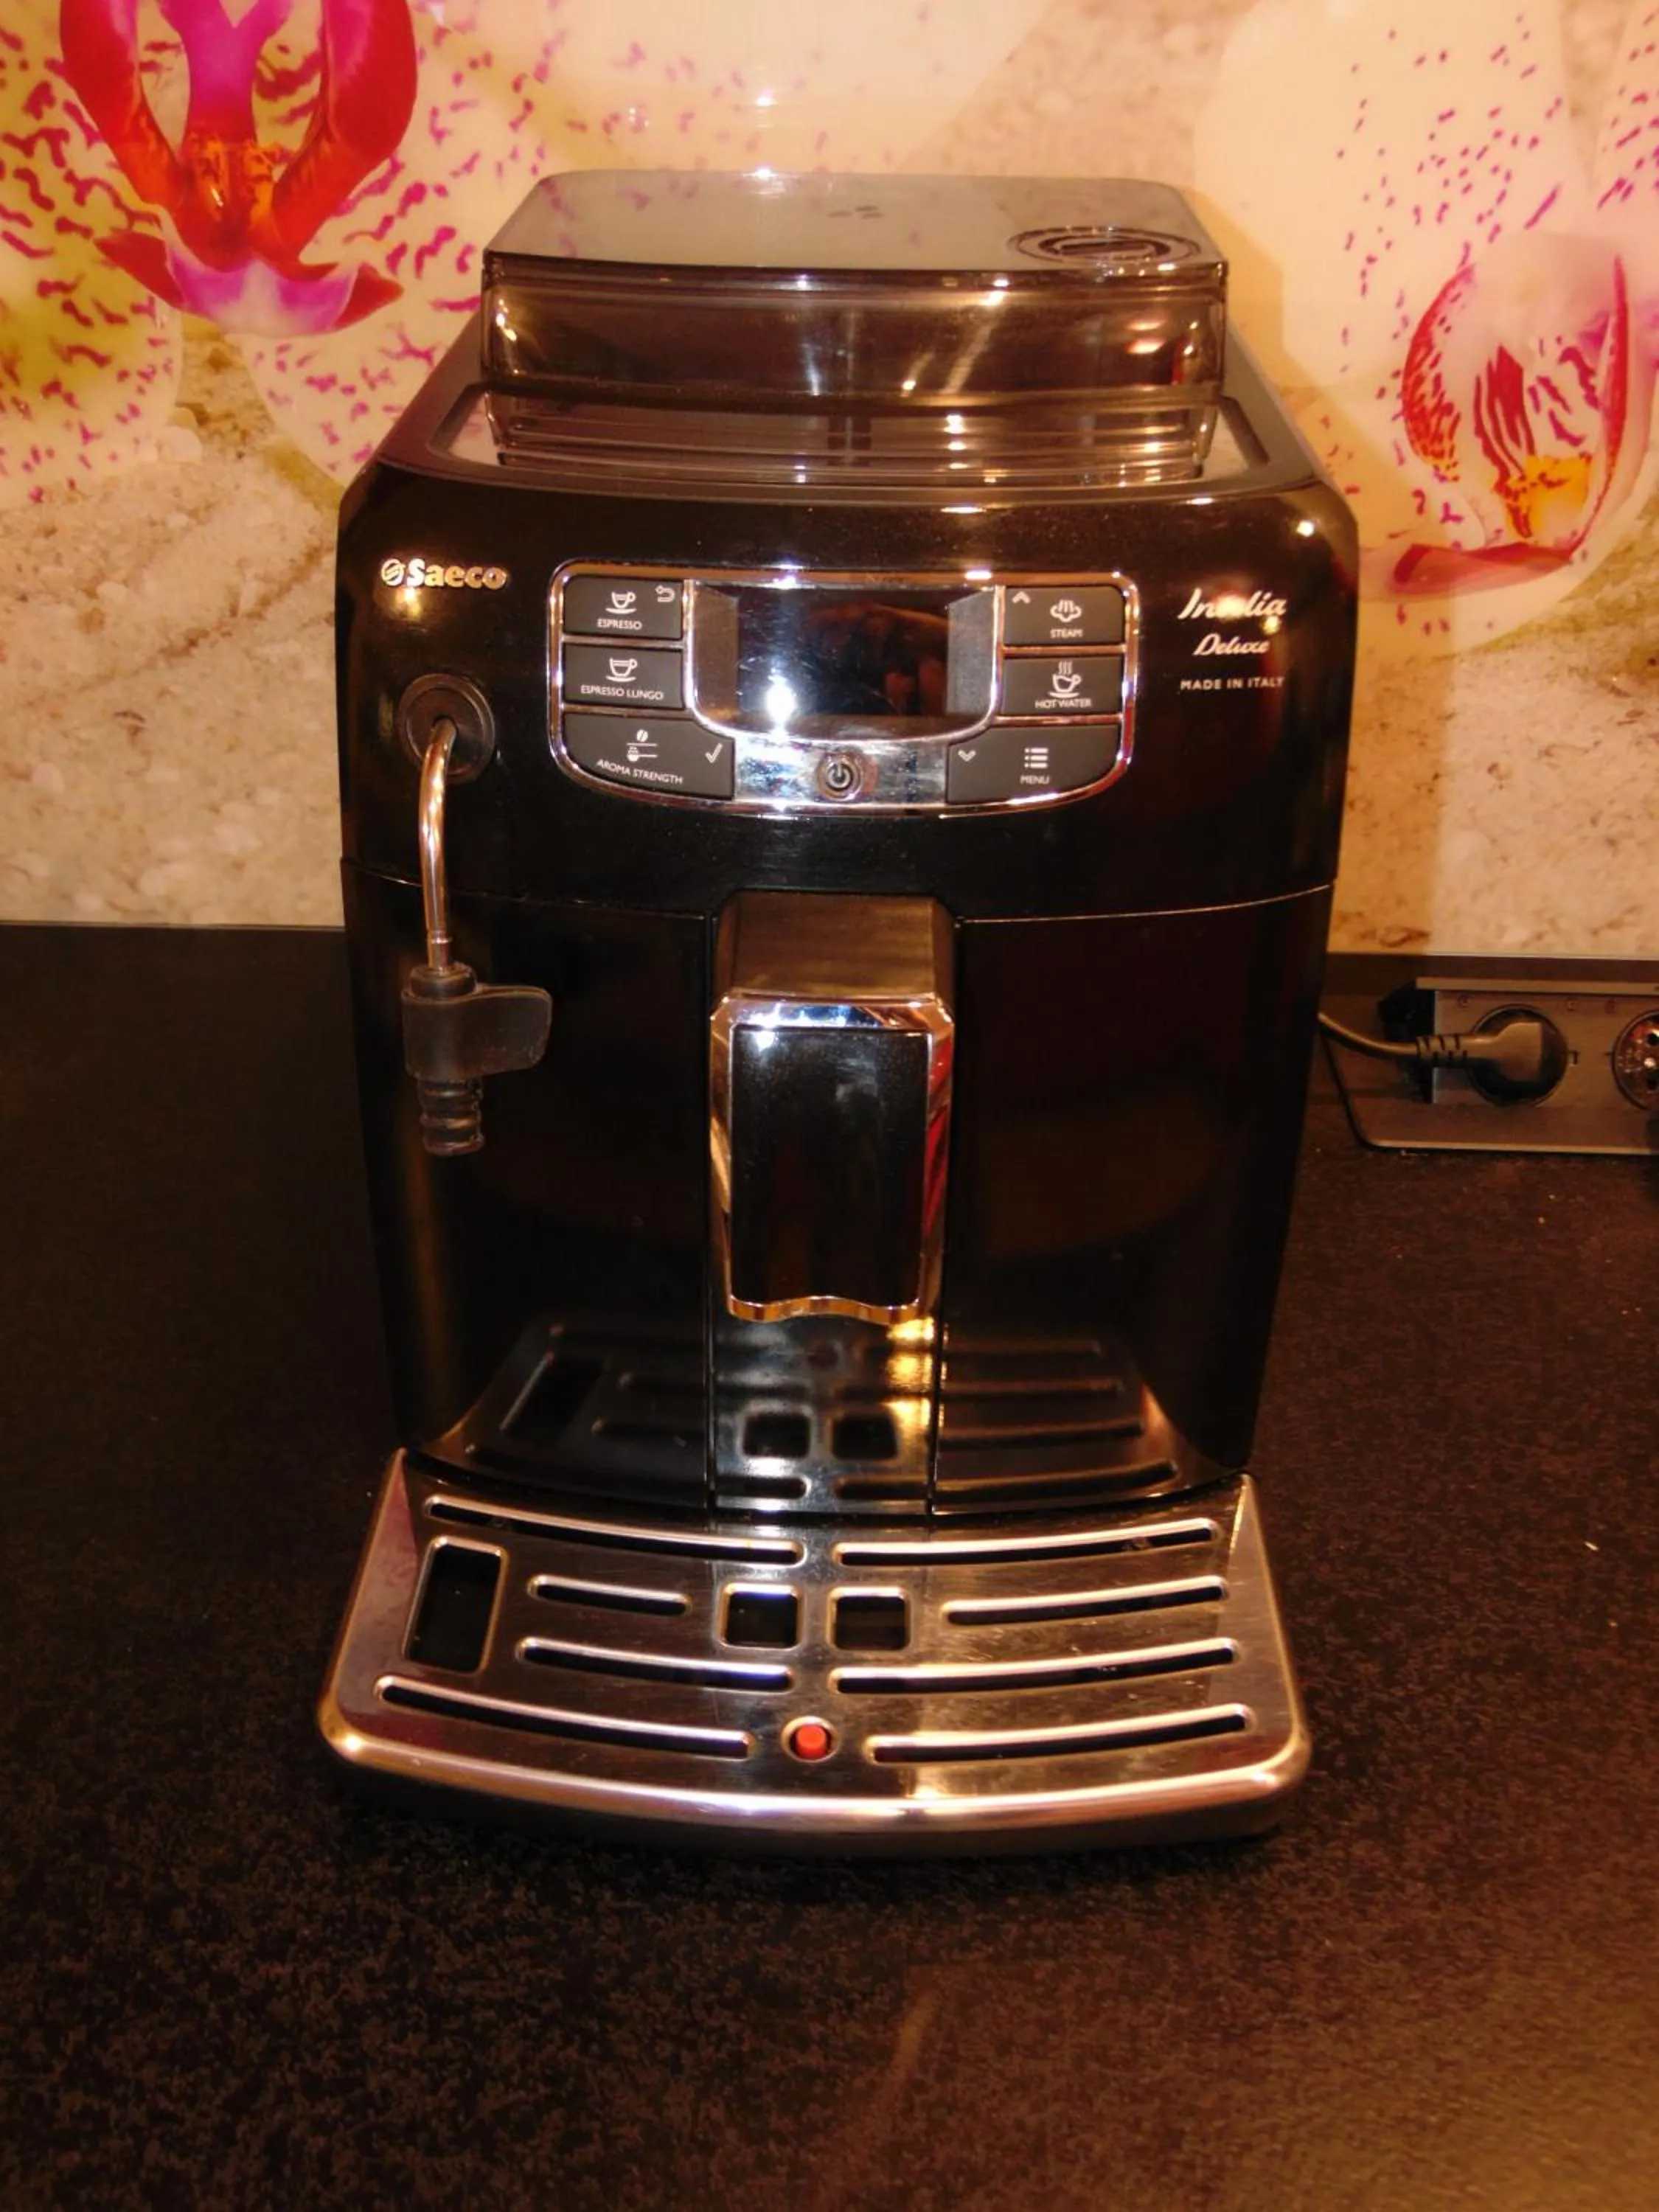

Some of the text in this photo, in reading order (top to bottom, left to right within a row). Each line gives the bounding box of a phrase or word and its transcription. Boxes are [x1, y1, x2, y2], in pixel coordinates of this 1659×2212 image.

[407, 558, 507, 590] Saeco
[1178, 588, 1287, 619] Inlia
[597, 618, 642, 631] ESPRESSO
[1050, 628, 1083, 639] STEAM
[1192, 633, 1270, 656] Deluxe
[1180, 676, 1284, 691] MADE IN ITALY
[580, 684, 664, 700] ESPRESSO LUNGO
[1034, 698, 1092, 709] HOT WATER
[597, 758, 684, 785] AROMA STRENGTH
[1020, 775, 1050, 785] MENU
